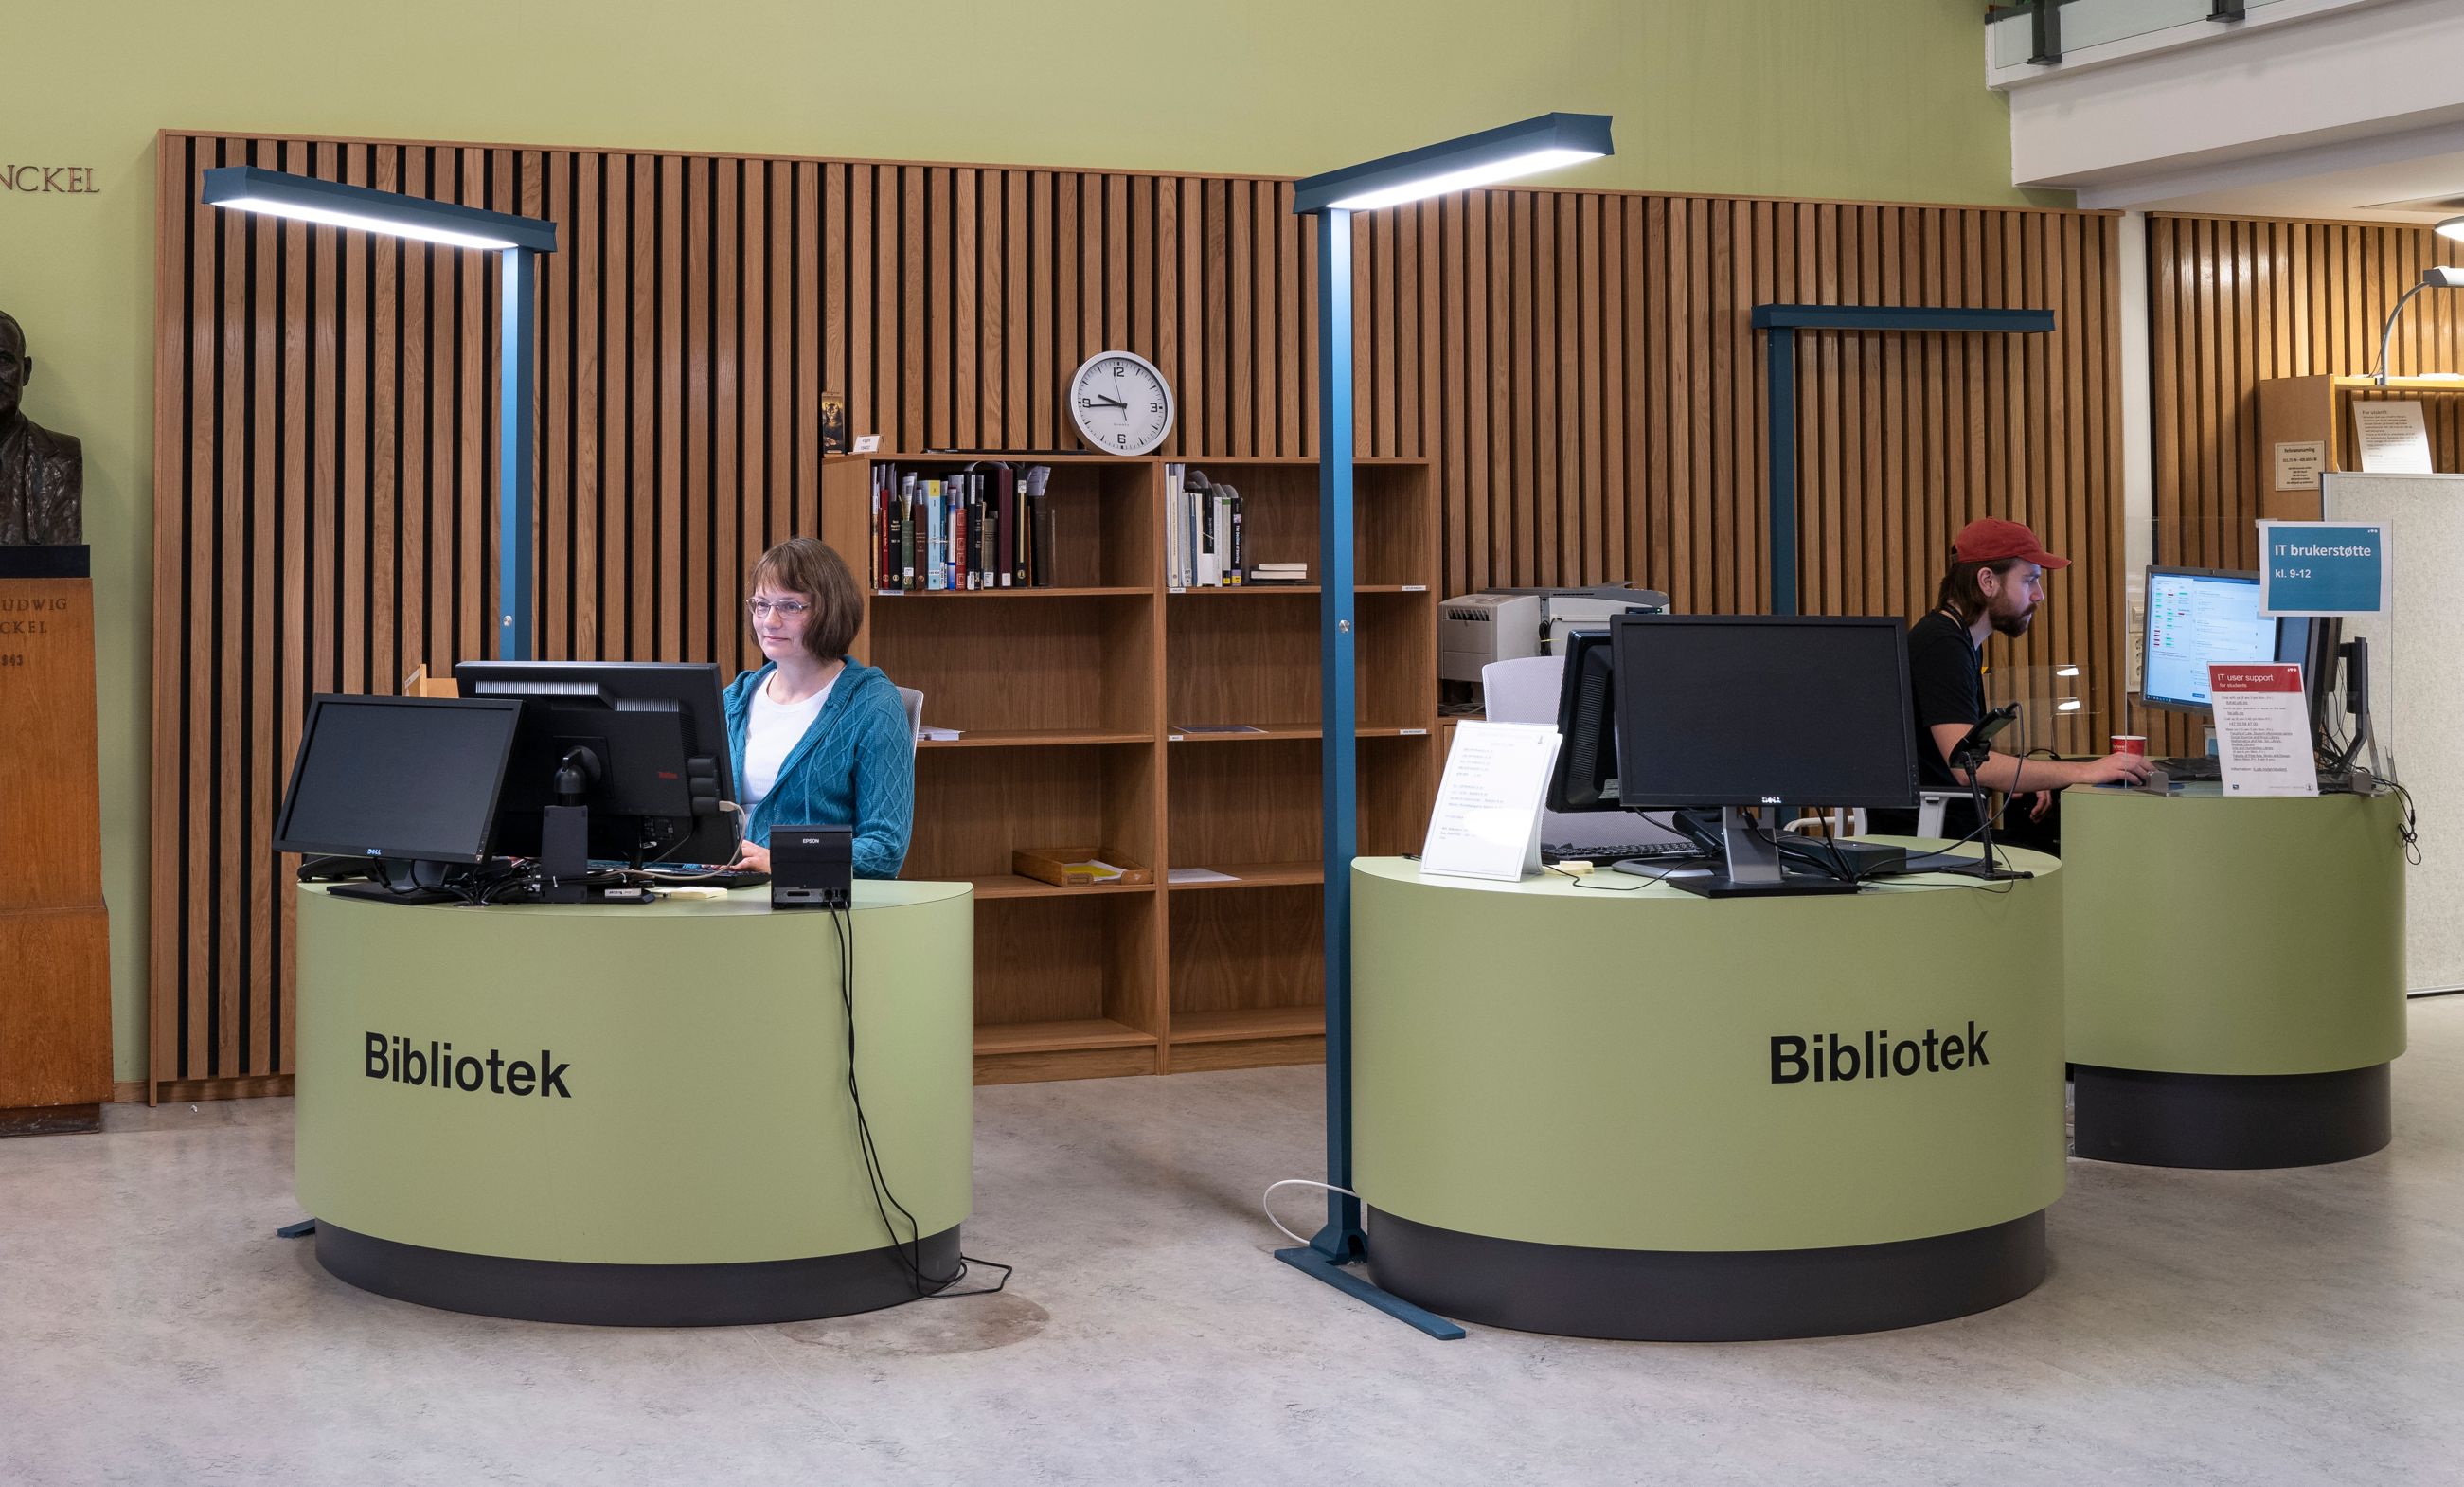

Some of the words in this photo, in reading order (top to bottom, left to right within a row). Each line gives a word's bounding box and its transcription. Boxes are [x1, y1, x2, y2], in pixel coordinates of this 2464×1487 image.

[1113, 367, 1125, 378] 12
[1081, 398, 1091, 408] 9
[1150, 402, 1158, 413] 3
[1117, 433, 1126, 444] 6
[2275, 544, 2287, 556] IT
[2290, 544, 2372, 558] brukerstøtte
[2275, 568, 2287, 578] kl.
[2289, 569, 2311, 579] 9-12
[2245, 673, 2274, 683] support
[366, 848, 382, 856] DELL
[1770, 1020, 1990, 1084] Bibliotek
[366, 1030, 572, 1099] Bibliotek
